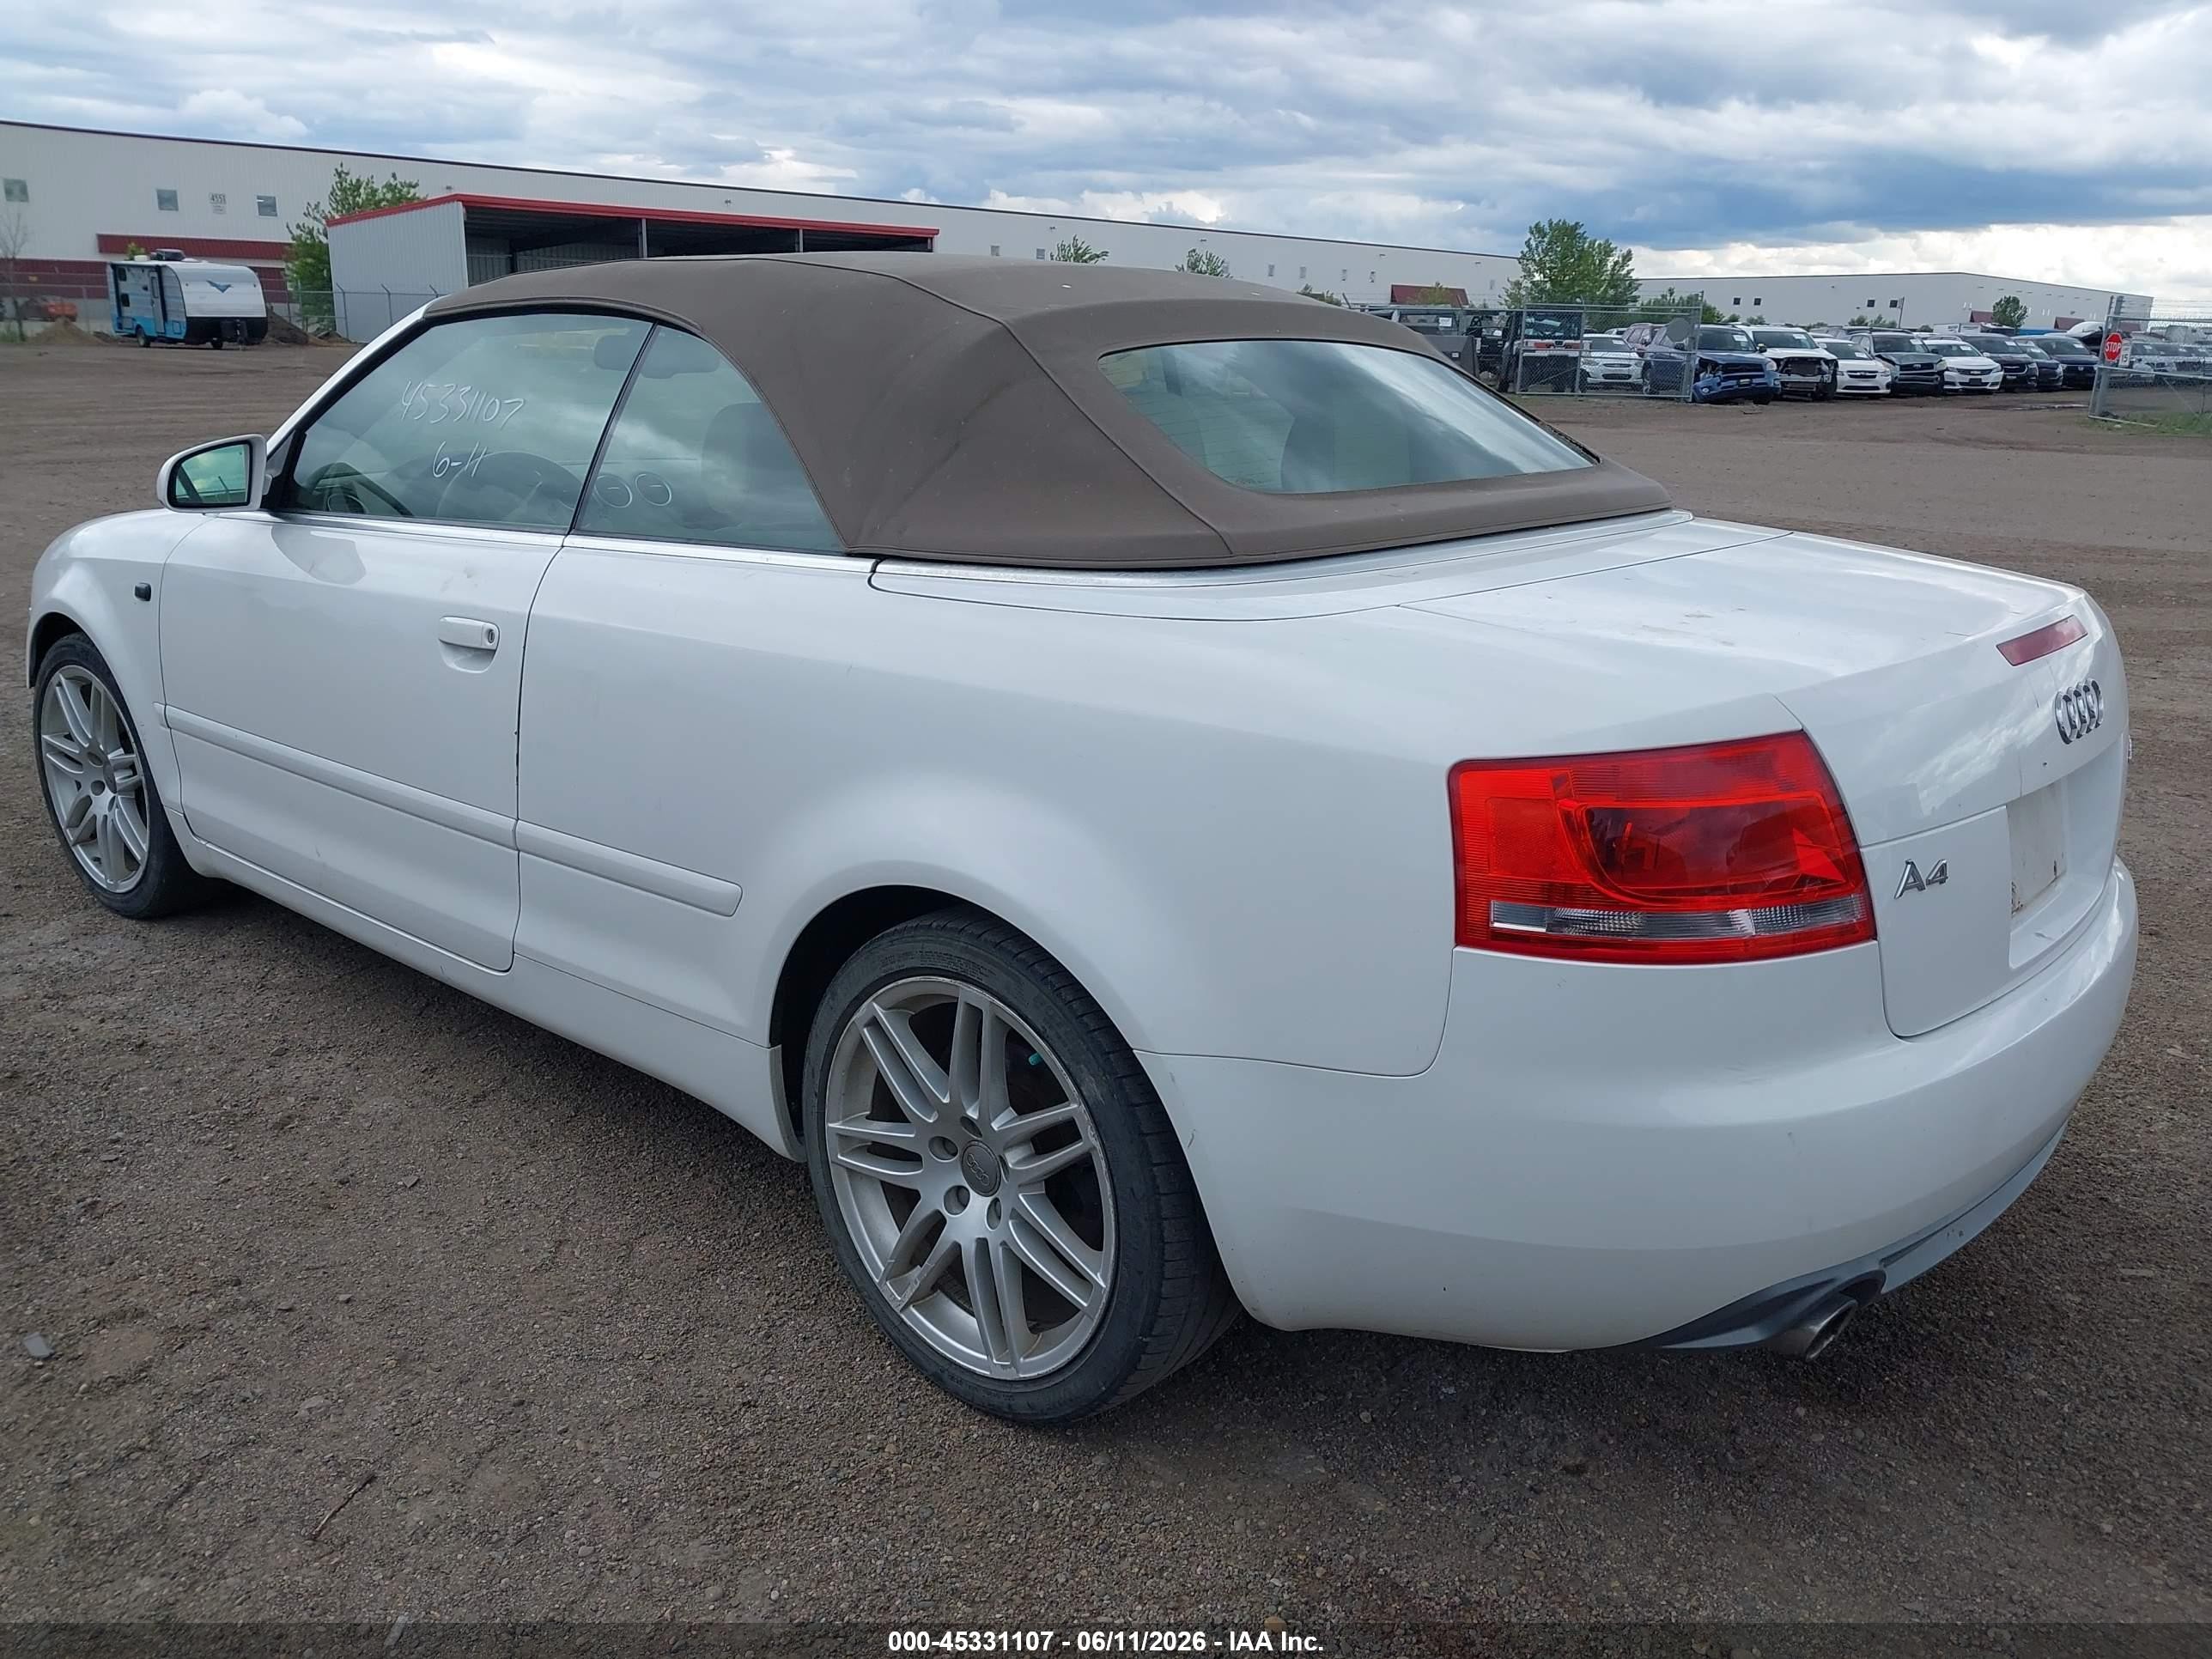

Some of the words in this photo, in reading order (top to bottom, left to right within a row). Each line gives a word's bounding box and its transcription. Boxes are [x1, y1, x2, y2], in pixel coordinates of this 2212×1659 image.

[2106, 342, 2122, 353] STOP
[2122, 354, 2129, 362] 15
[402, 380, 525, 429] 45331107
[1894, 859, 1948, 899] A4
